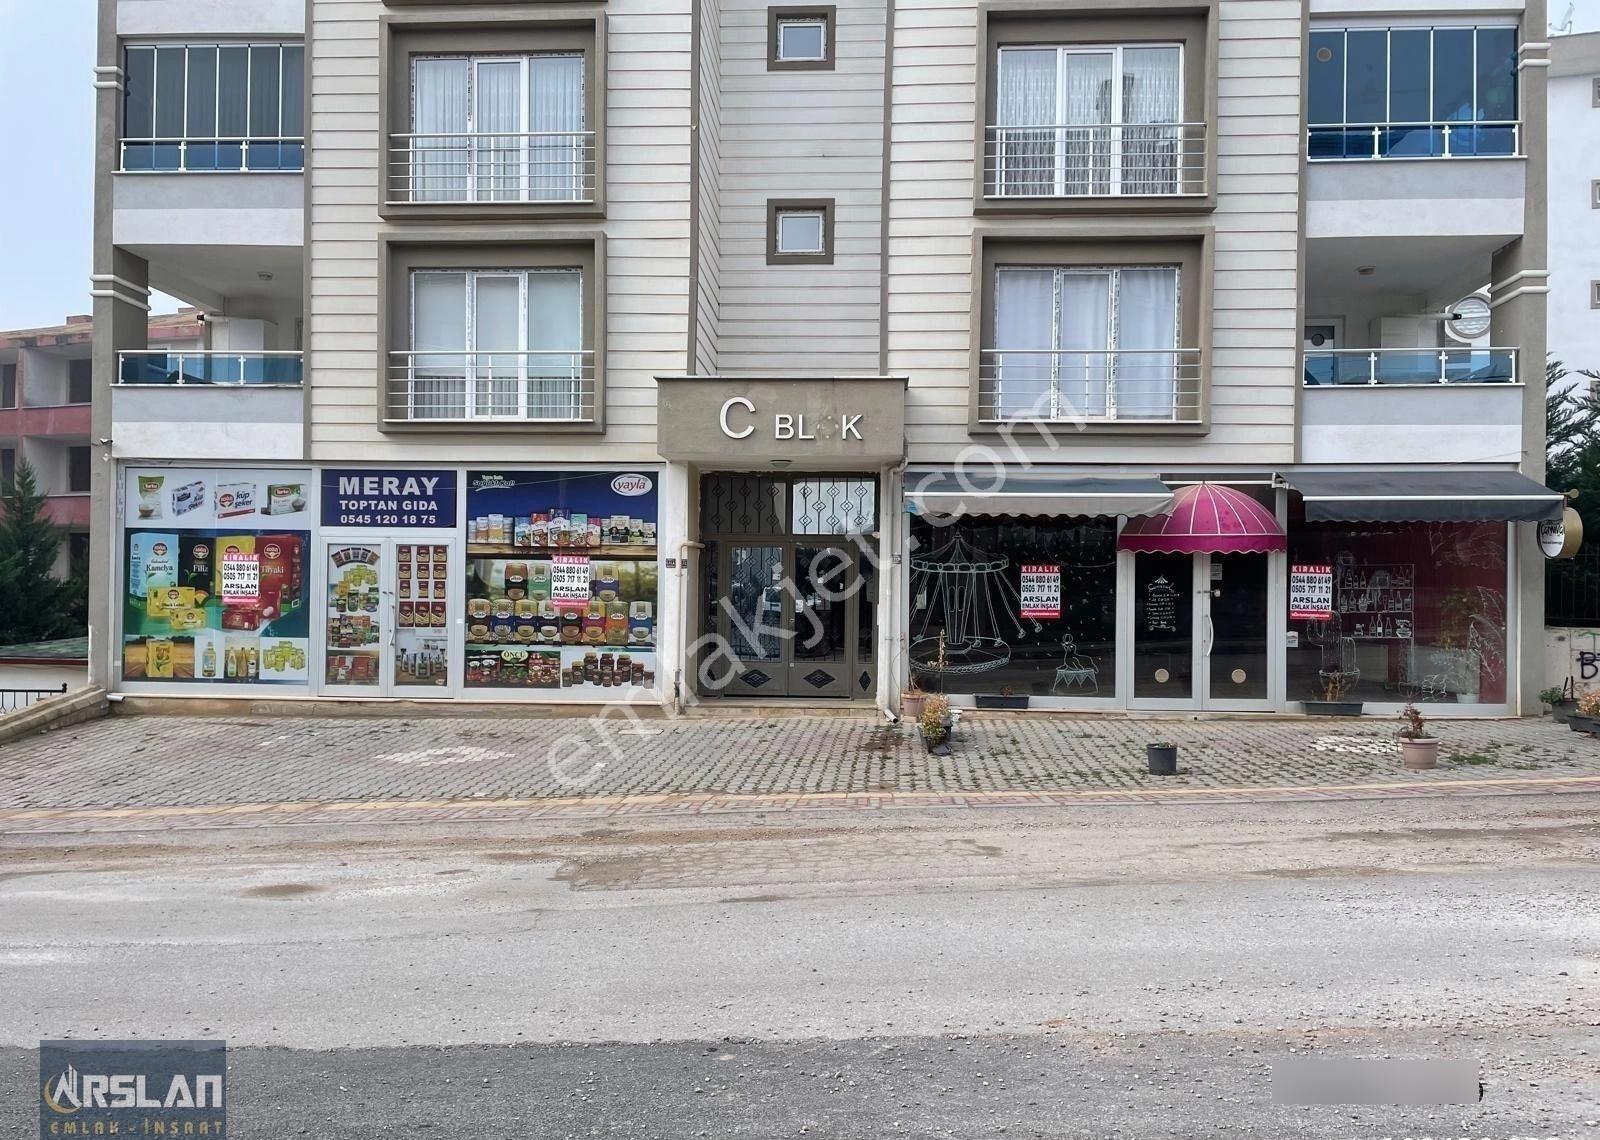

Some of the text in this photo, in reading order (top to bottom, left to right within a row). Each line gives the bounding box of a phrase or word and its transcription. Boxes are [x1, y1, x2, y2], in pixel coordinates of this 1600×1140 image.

[719, 397, 756, 439] C
[339, 477, 439, 495] MERAY
[617, 479, 646, 491] yayla
[236, 490, 250, 502] küp
[235, 499, 252, 508] şeker
[339, 500, 438, 511] TOPTAN GIDA
[340, 514, 436, 524] 0545 120 18 75
[146, 564, 173, 572] Kamelya
[552, 566, 589, 574] 0544 880 61 49
[223, 572, 236, 580] 0505
[237, 572, 246, 580] 717
[252, 572, 258, 580] 21
[552, 575, 565, 583] 0505
[567, 575, 575, 583] 717
[1021, 575, 1060, 584] 0544 880 61 49
[1291, 575, 1331, 585] 0544 880 61 49
[1021, 584, 1035, 593] 0505
[1037, 584, 1046, 593] 717
[1053, 584, 1060, 593] 21
[1291, 584, 1305, 593] 0505
[1307, 585, 1317, 593] 717
[1325, 585, 1331, 594] 21
[1292, 596, 1330, 604] ARSLAN
